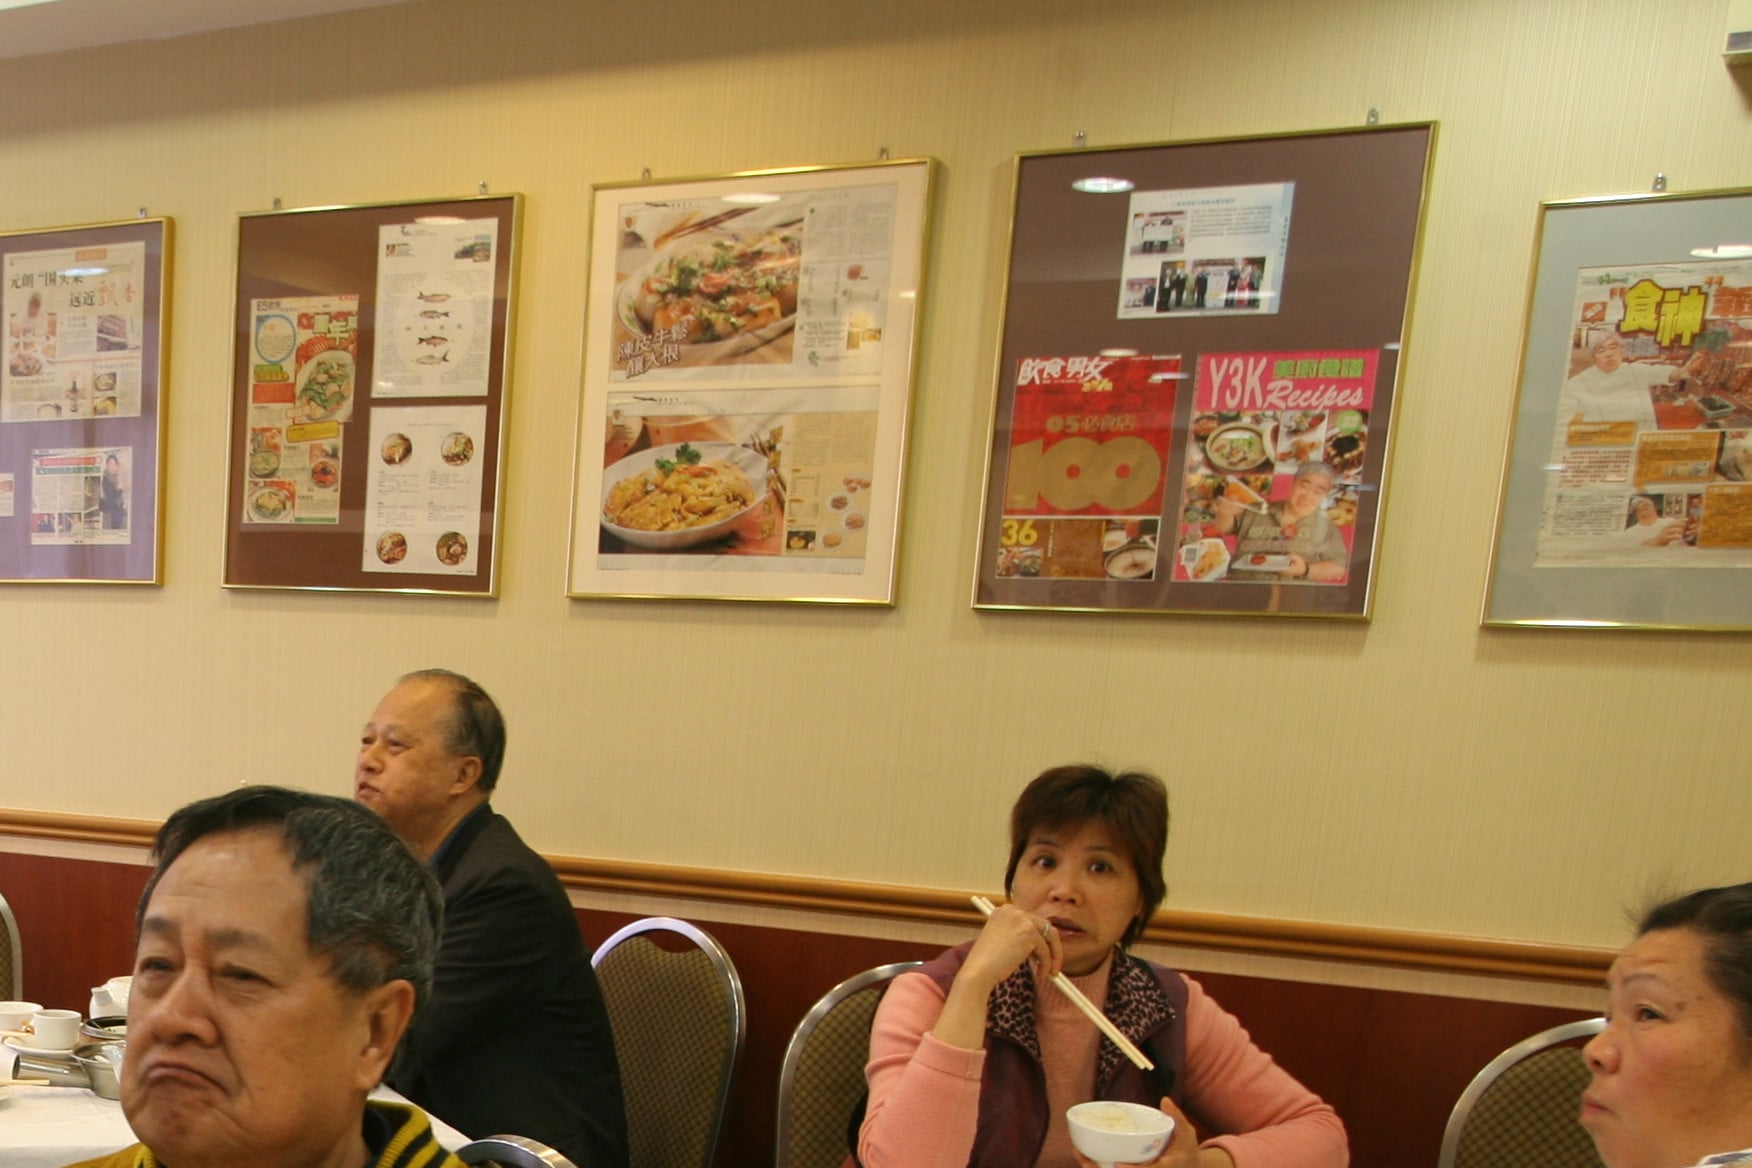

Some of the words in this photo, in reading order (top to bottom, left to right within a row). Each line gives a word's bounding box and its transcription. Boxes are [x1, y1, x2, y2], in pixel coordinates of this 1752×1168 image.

[1210, 357, 1267, 409] Y3K
[1263, 379, 1364, 410] Recipes
[1005, 436, 1161, 511] 100
[1001, 519, 1038, 546] 36
